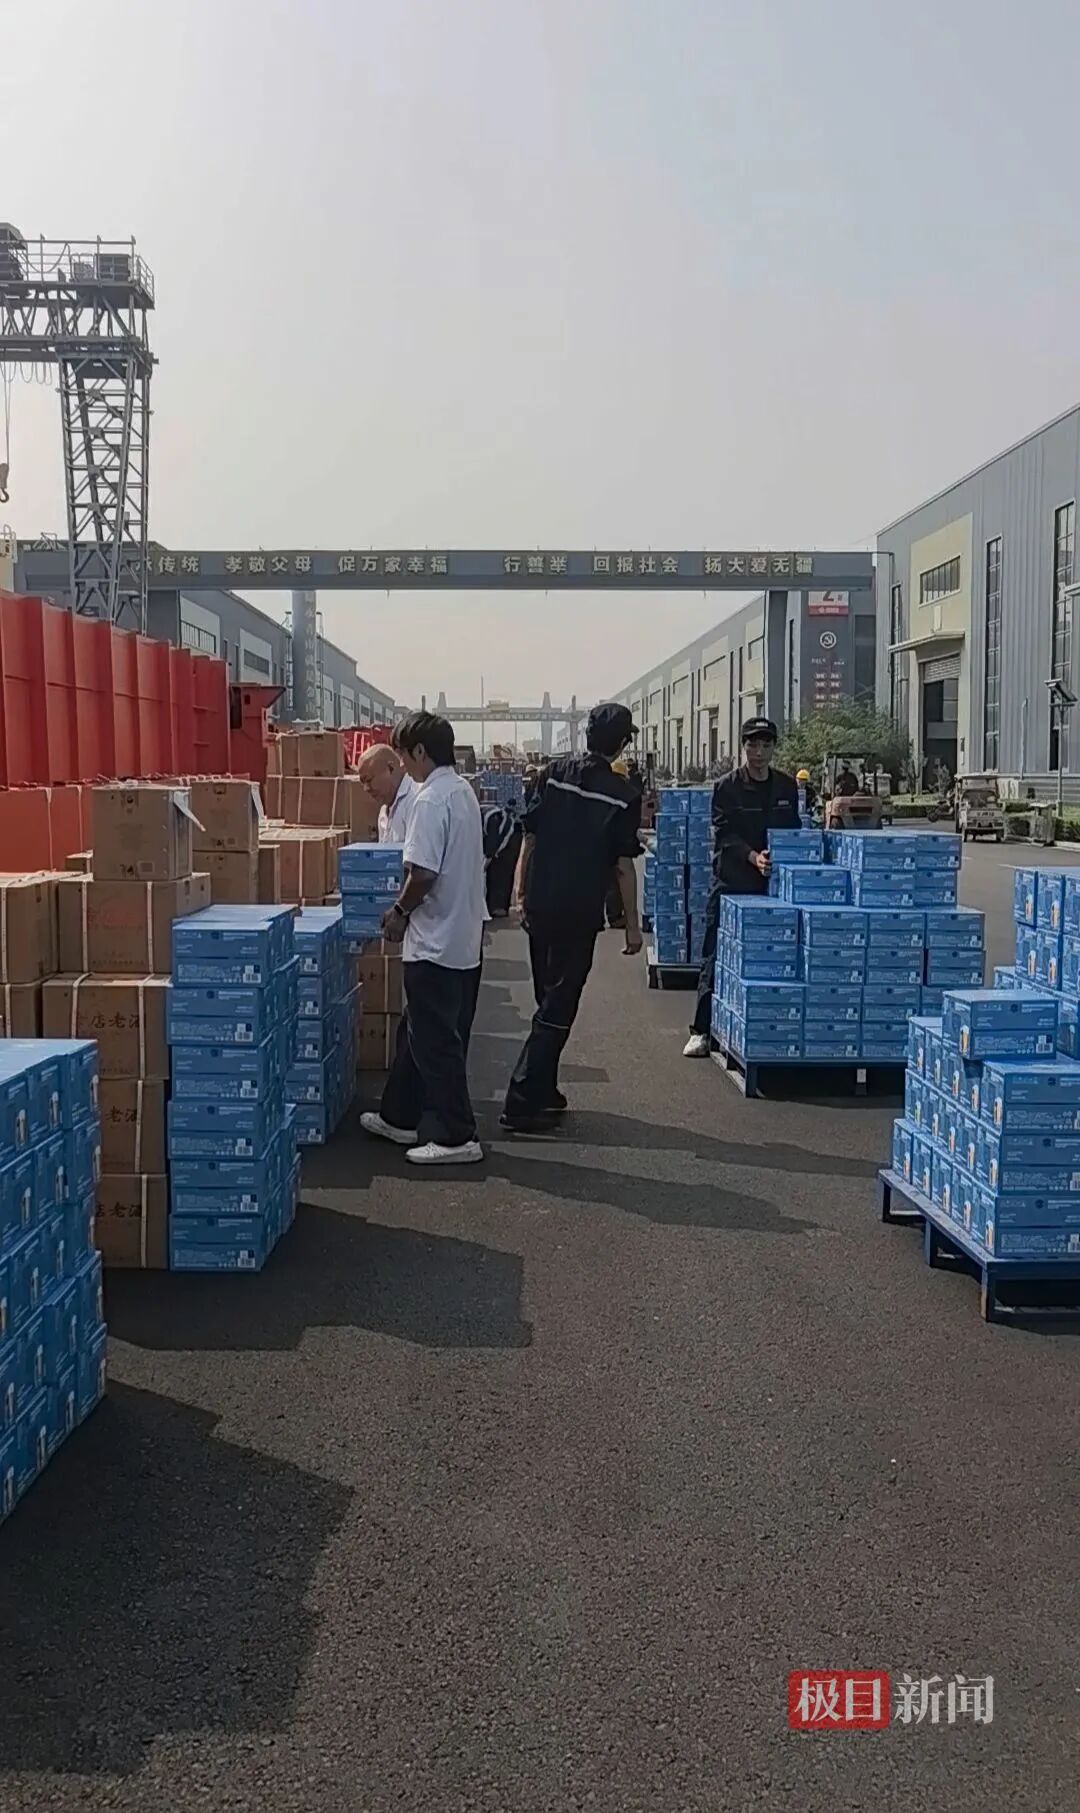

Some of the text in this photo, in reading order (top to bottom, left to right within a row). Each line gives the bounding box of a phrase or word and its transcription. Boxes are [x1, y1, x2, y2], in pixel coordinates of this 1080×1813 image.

[225, 556, 313, 573] 孝敬父母
[338, 555, 448, 573] 促万家幸福
[503, 556, 568, 574] 行善举
[593, 556, 679, 574] 回报社会
[704, 556, 813, 574] 扬大爱无疆
